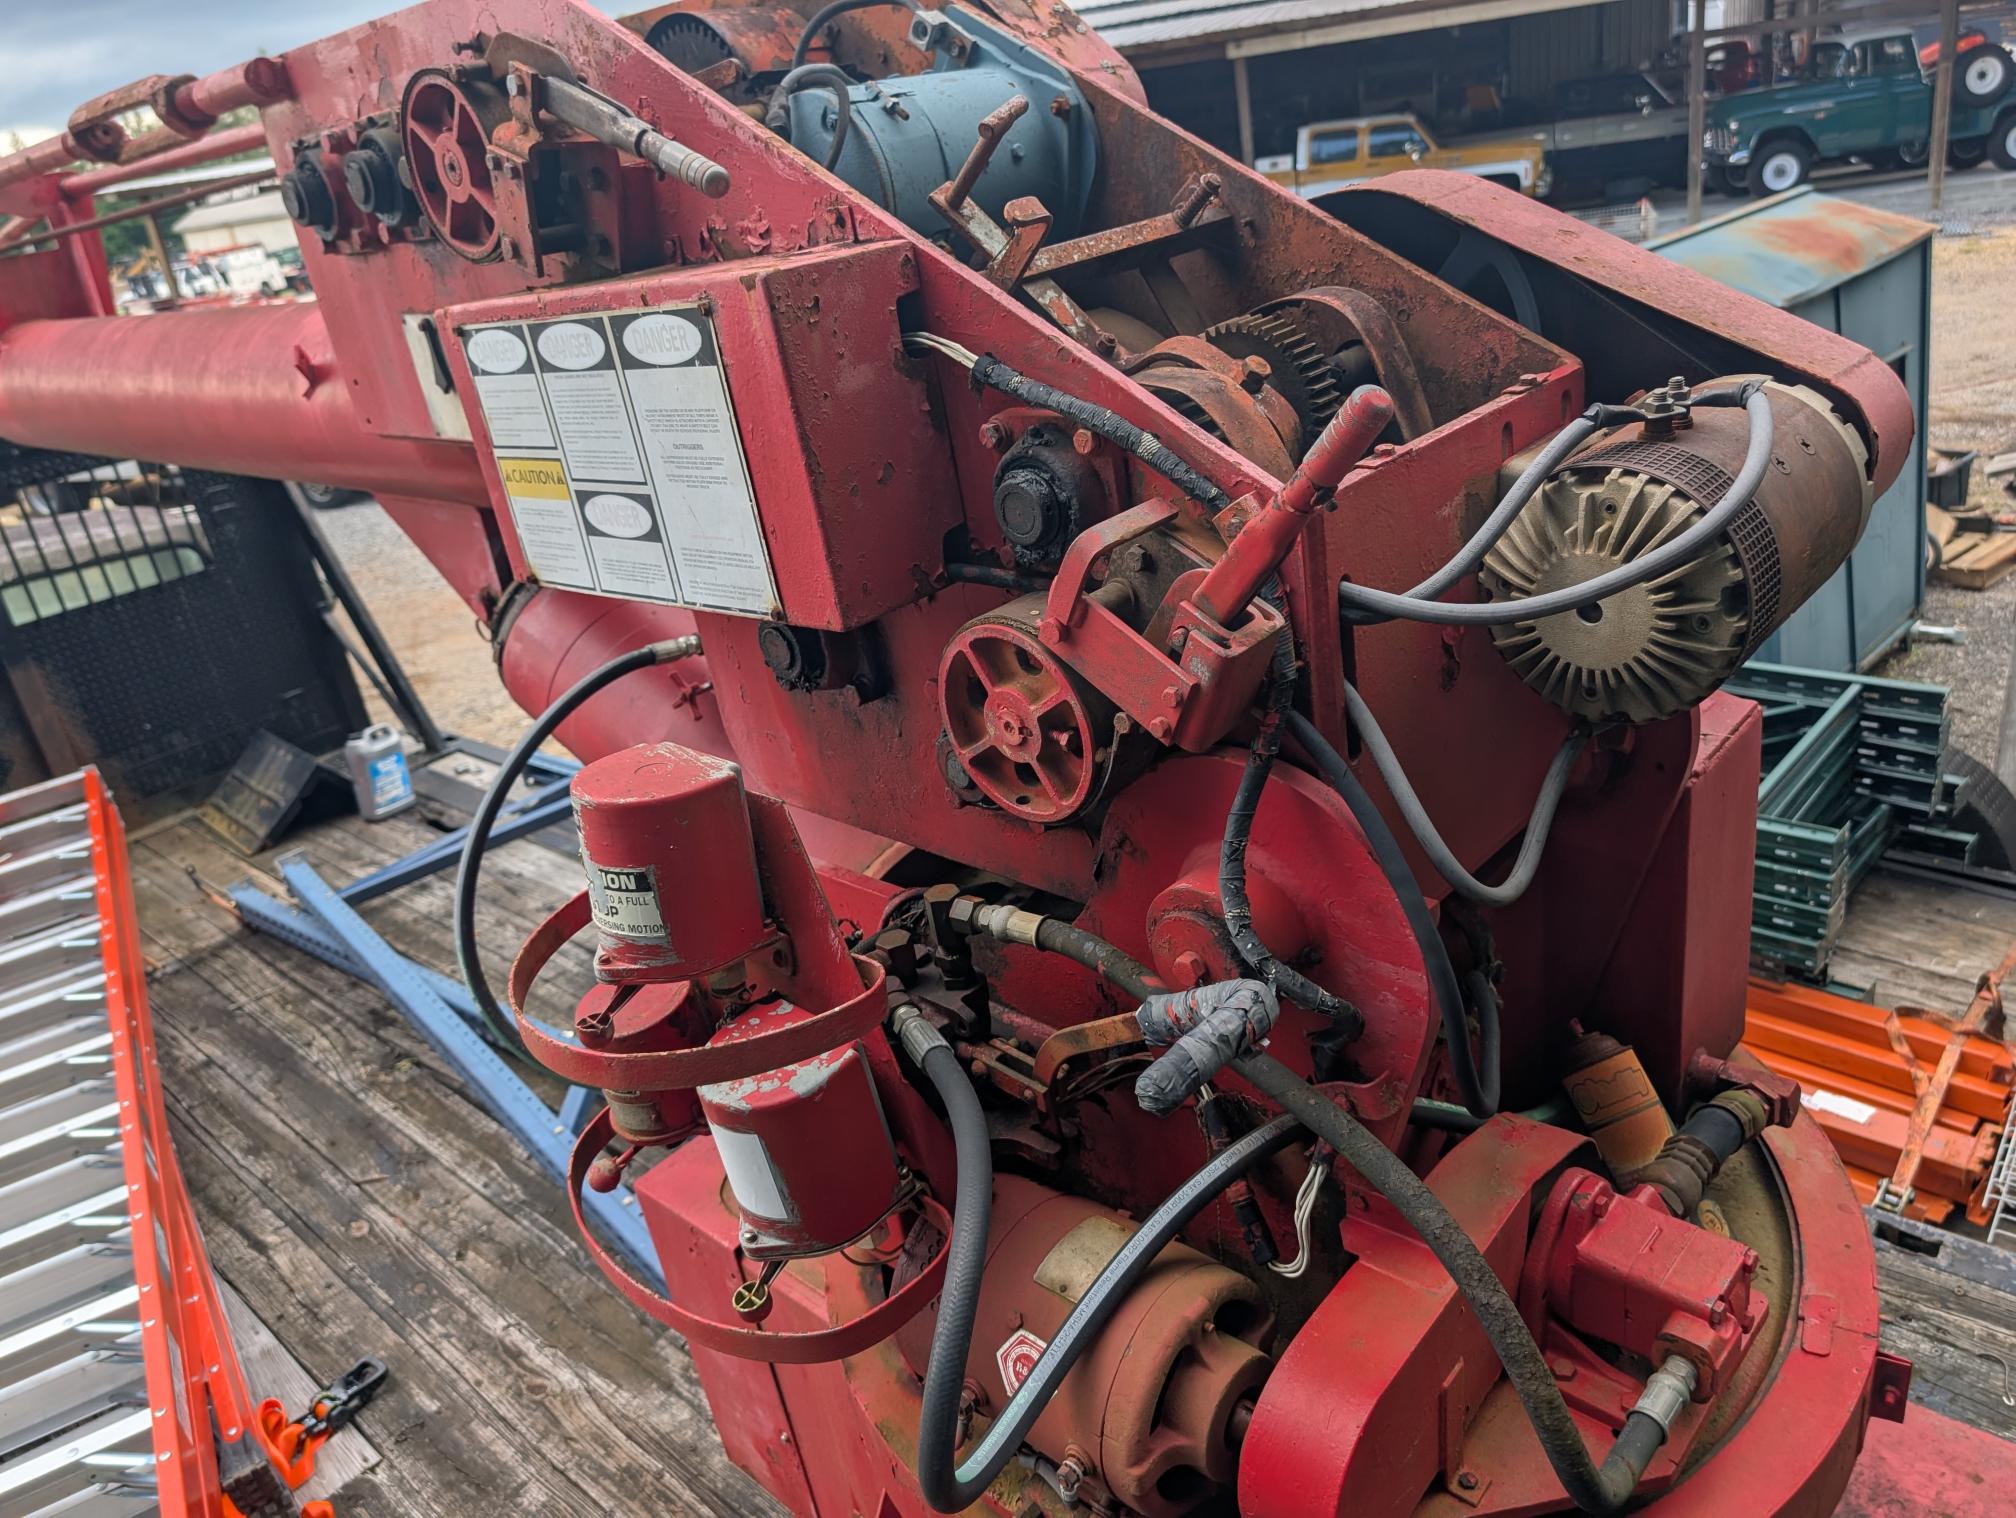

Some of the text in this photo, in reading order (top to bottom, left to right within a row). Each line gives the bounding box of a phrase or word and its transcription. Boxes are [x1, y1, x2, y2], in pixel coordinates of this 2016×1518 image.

[473, 337, 520, 364] DANGER
[543, 331, 597, 360] DANGER
[631, 324, 691, 354] DANGER
[512, 469, 557, 485] CAUTION
[590, 499, 642, 531] DANGER
[602, 872, 637, 890] ION
[617, 896, 624, 905] A
[625, 897, 649, 906] FULL
[628, 924, 664, 934] MOTION
[1109, 1253, 1129, 1274] Flame
[1083, 1275, 1112, 1310] Resistant
